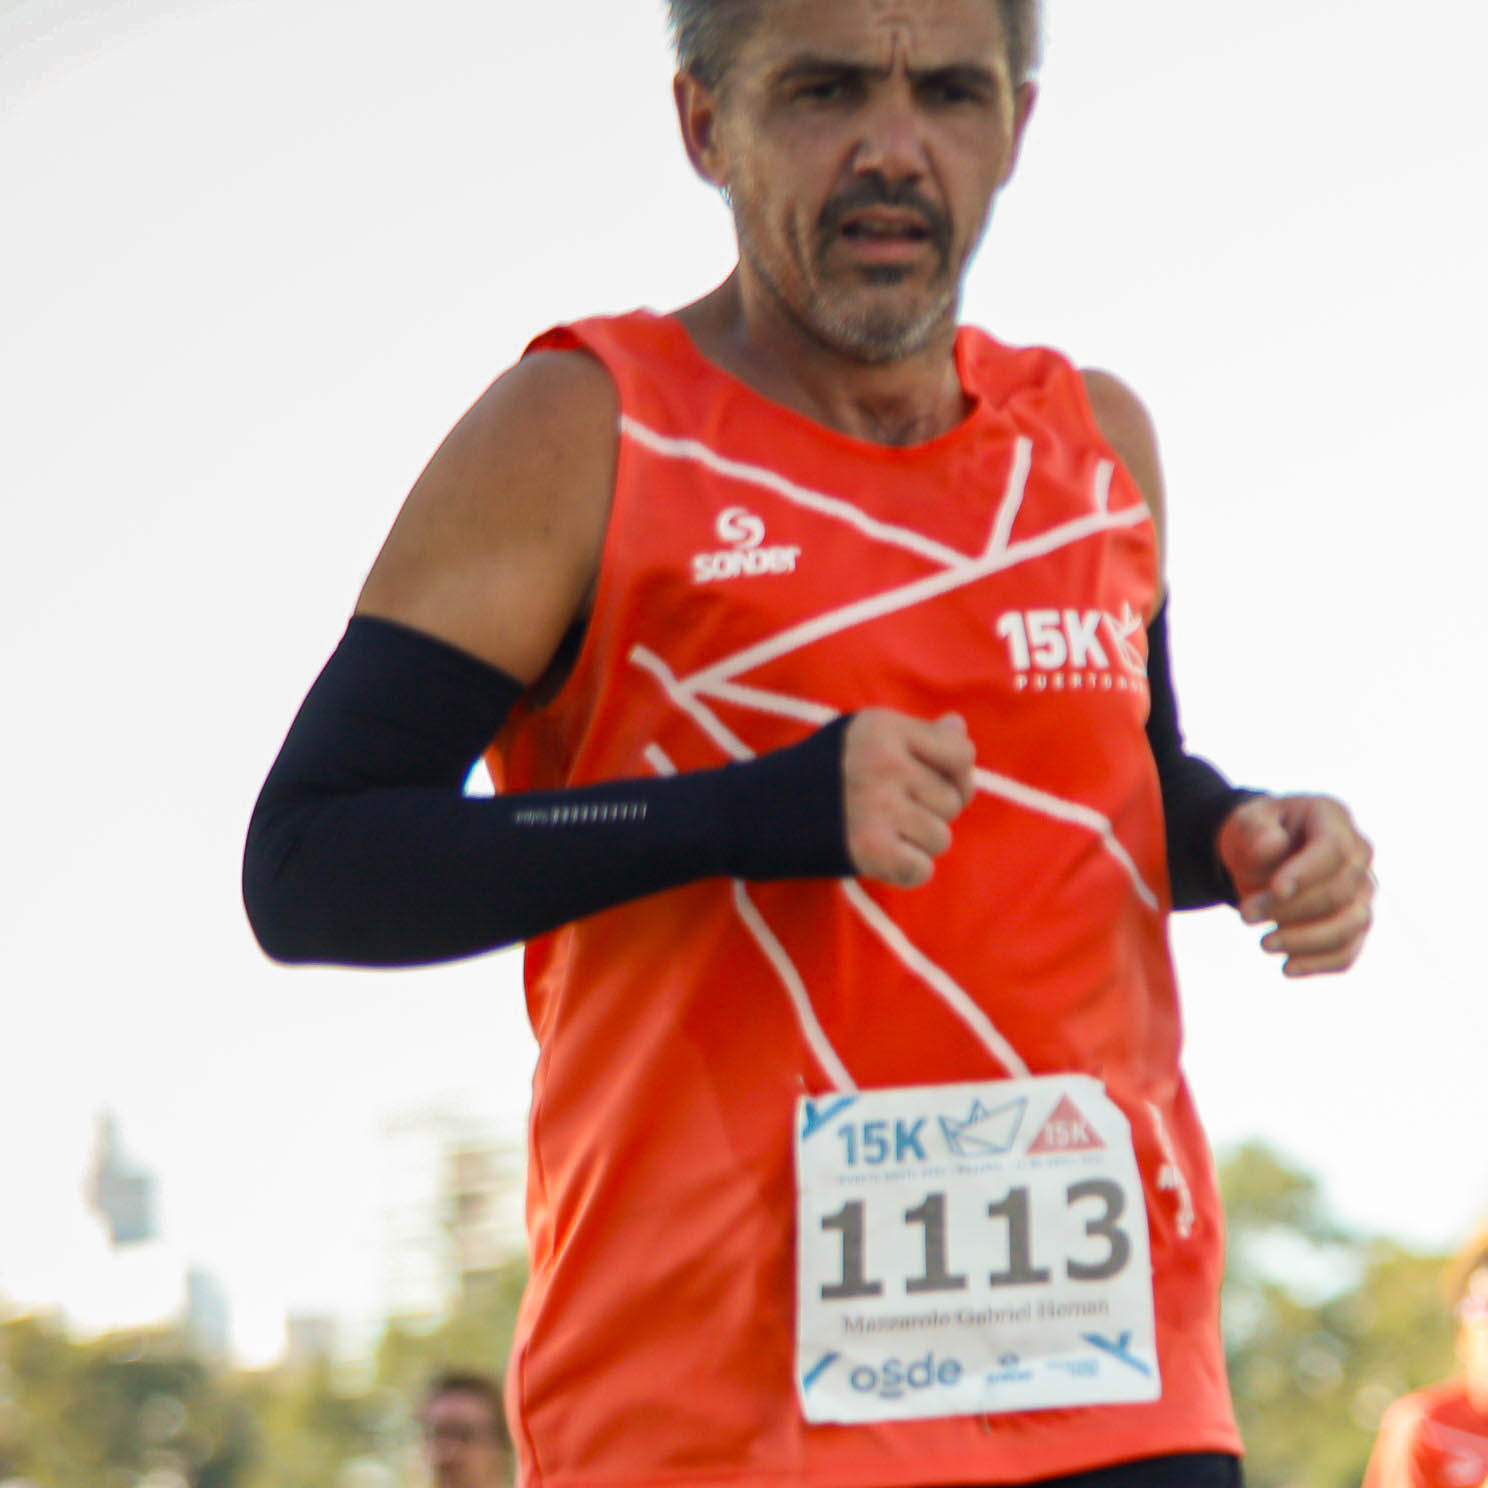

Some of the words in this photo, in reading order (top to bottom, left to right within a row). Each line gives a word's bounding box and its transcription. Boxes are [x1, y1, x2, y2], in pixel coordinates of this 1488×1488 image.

[996, 609, 1110, 672] 15K
[838, 1116, 929, 1168] 15K
[819, 1177, 1132, 1300] 1113
[850, 1352, 964, 1396] osde
